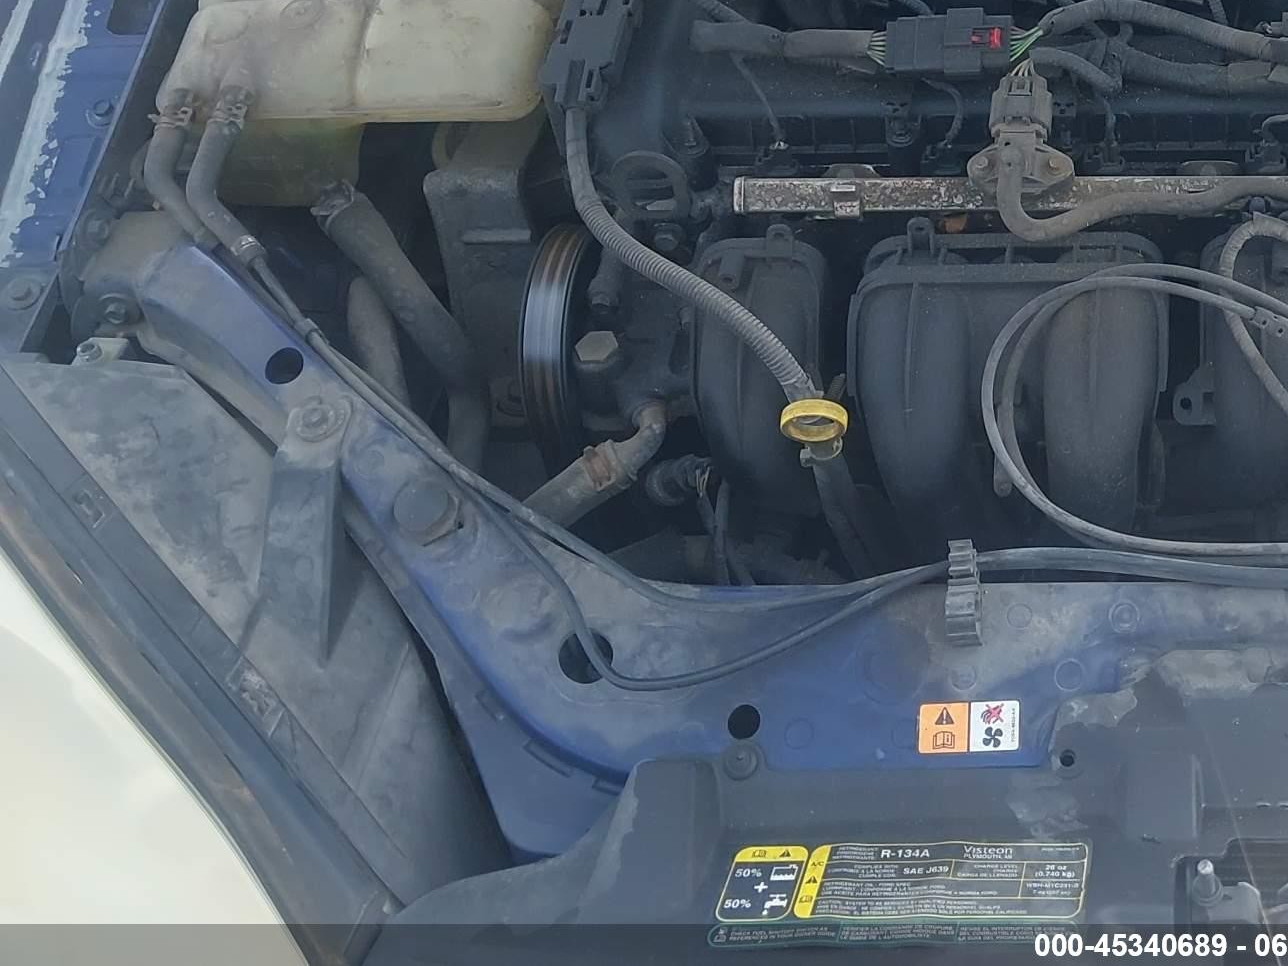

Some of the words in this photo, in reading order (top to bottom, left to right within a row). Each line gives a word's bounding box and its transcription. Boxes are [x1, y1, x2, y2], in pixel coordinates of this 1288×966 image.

[880, 848, 930, 859] R-134A
[964, 845, 1013, 855] Visteon
[735, 868, 762, 878] 50%
[903, 867, 924, 875] SAE
[925, 865, 949, 874] J639
[723, 898, 752, 909] 50%
